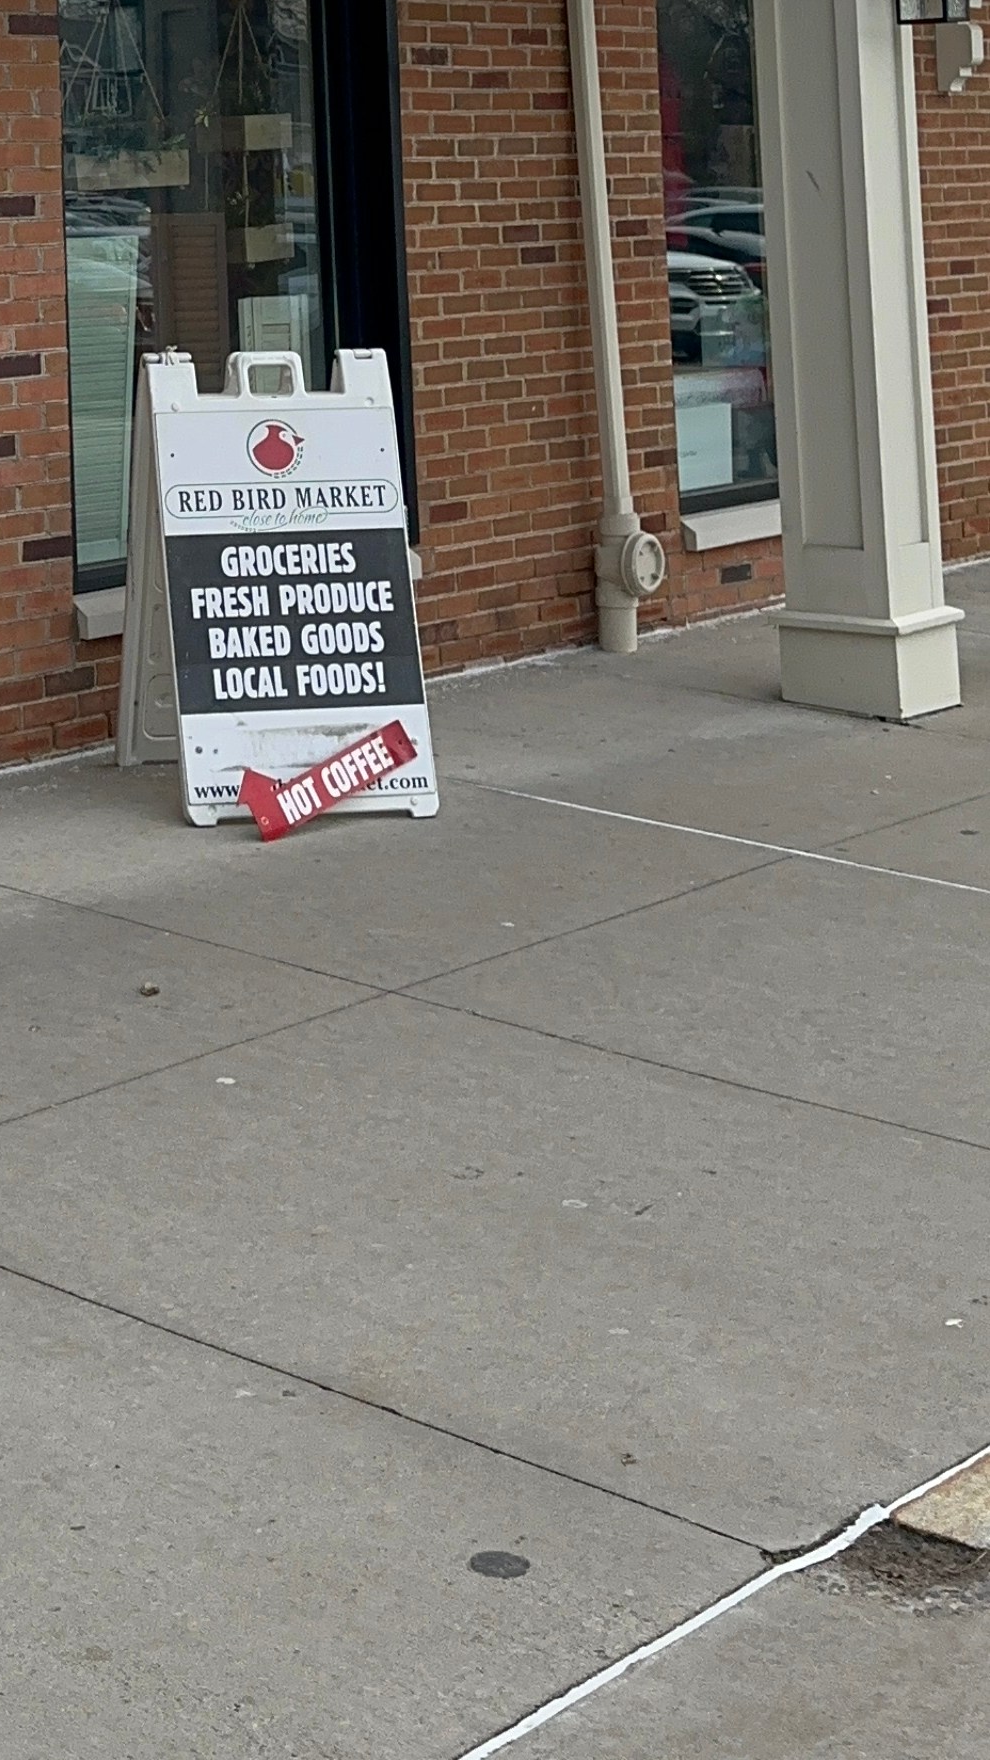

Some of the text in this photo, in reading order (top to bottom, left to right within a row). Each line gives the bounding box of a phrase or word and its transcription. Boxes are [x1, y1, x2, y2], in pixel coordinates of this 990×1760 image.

[178, 484, 386, 512] RED BIRD MARKET
[242, 508, 328, 527] close to home
[221, 542, 357, 577] GROCERIES
[191, 580, 395, 619] FRESH PRODUCE
[209, 621, 385, 659] BAKED GOODS
[213, 661, 386, 700] LOCAL FOODS!
[276, 736, 395, 826] HOT COFFEE
